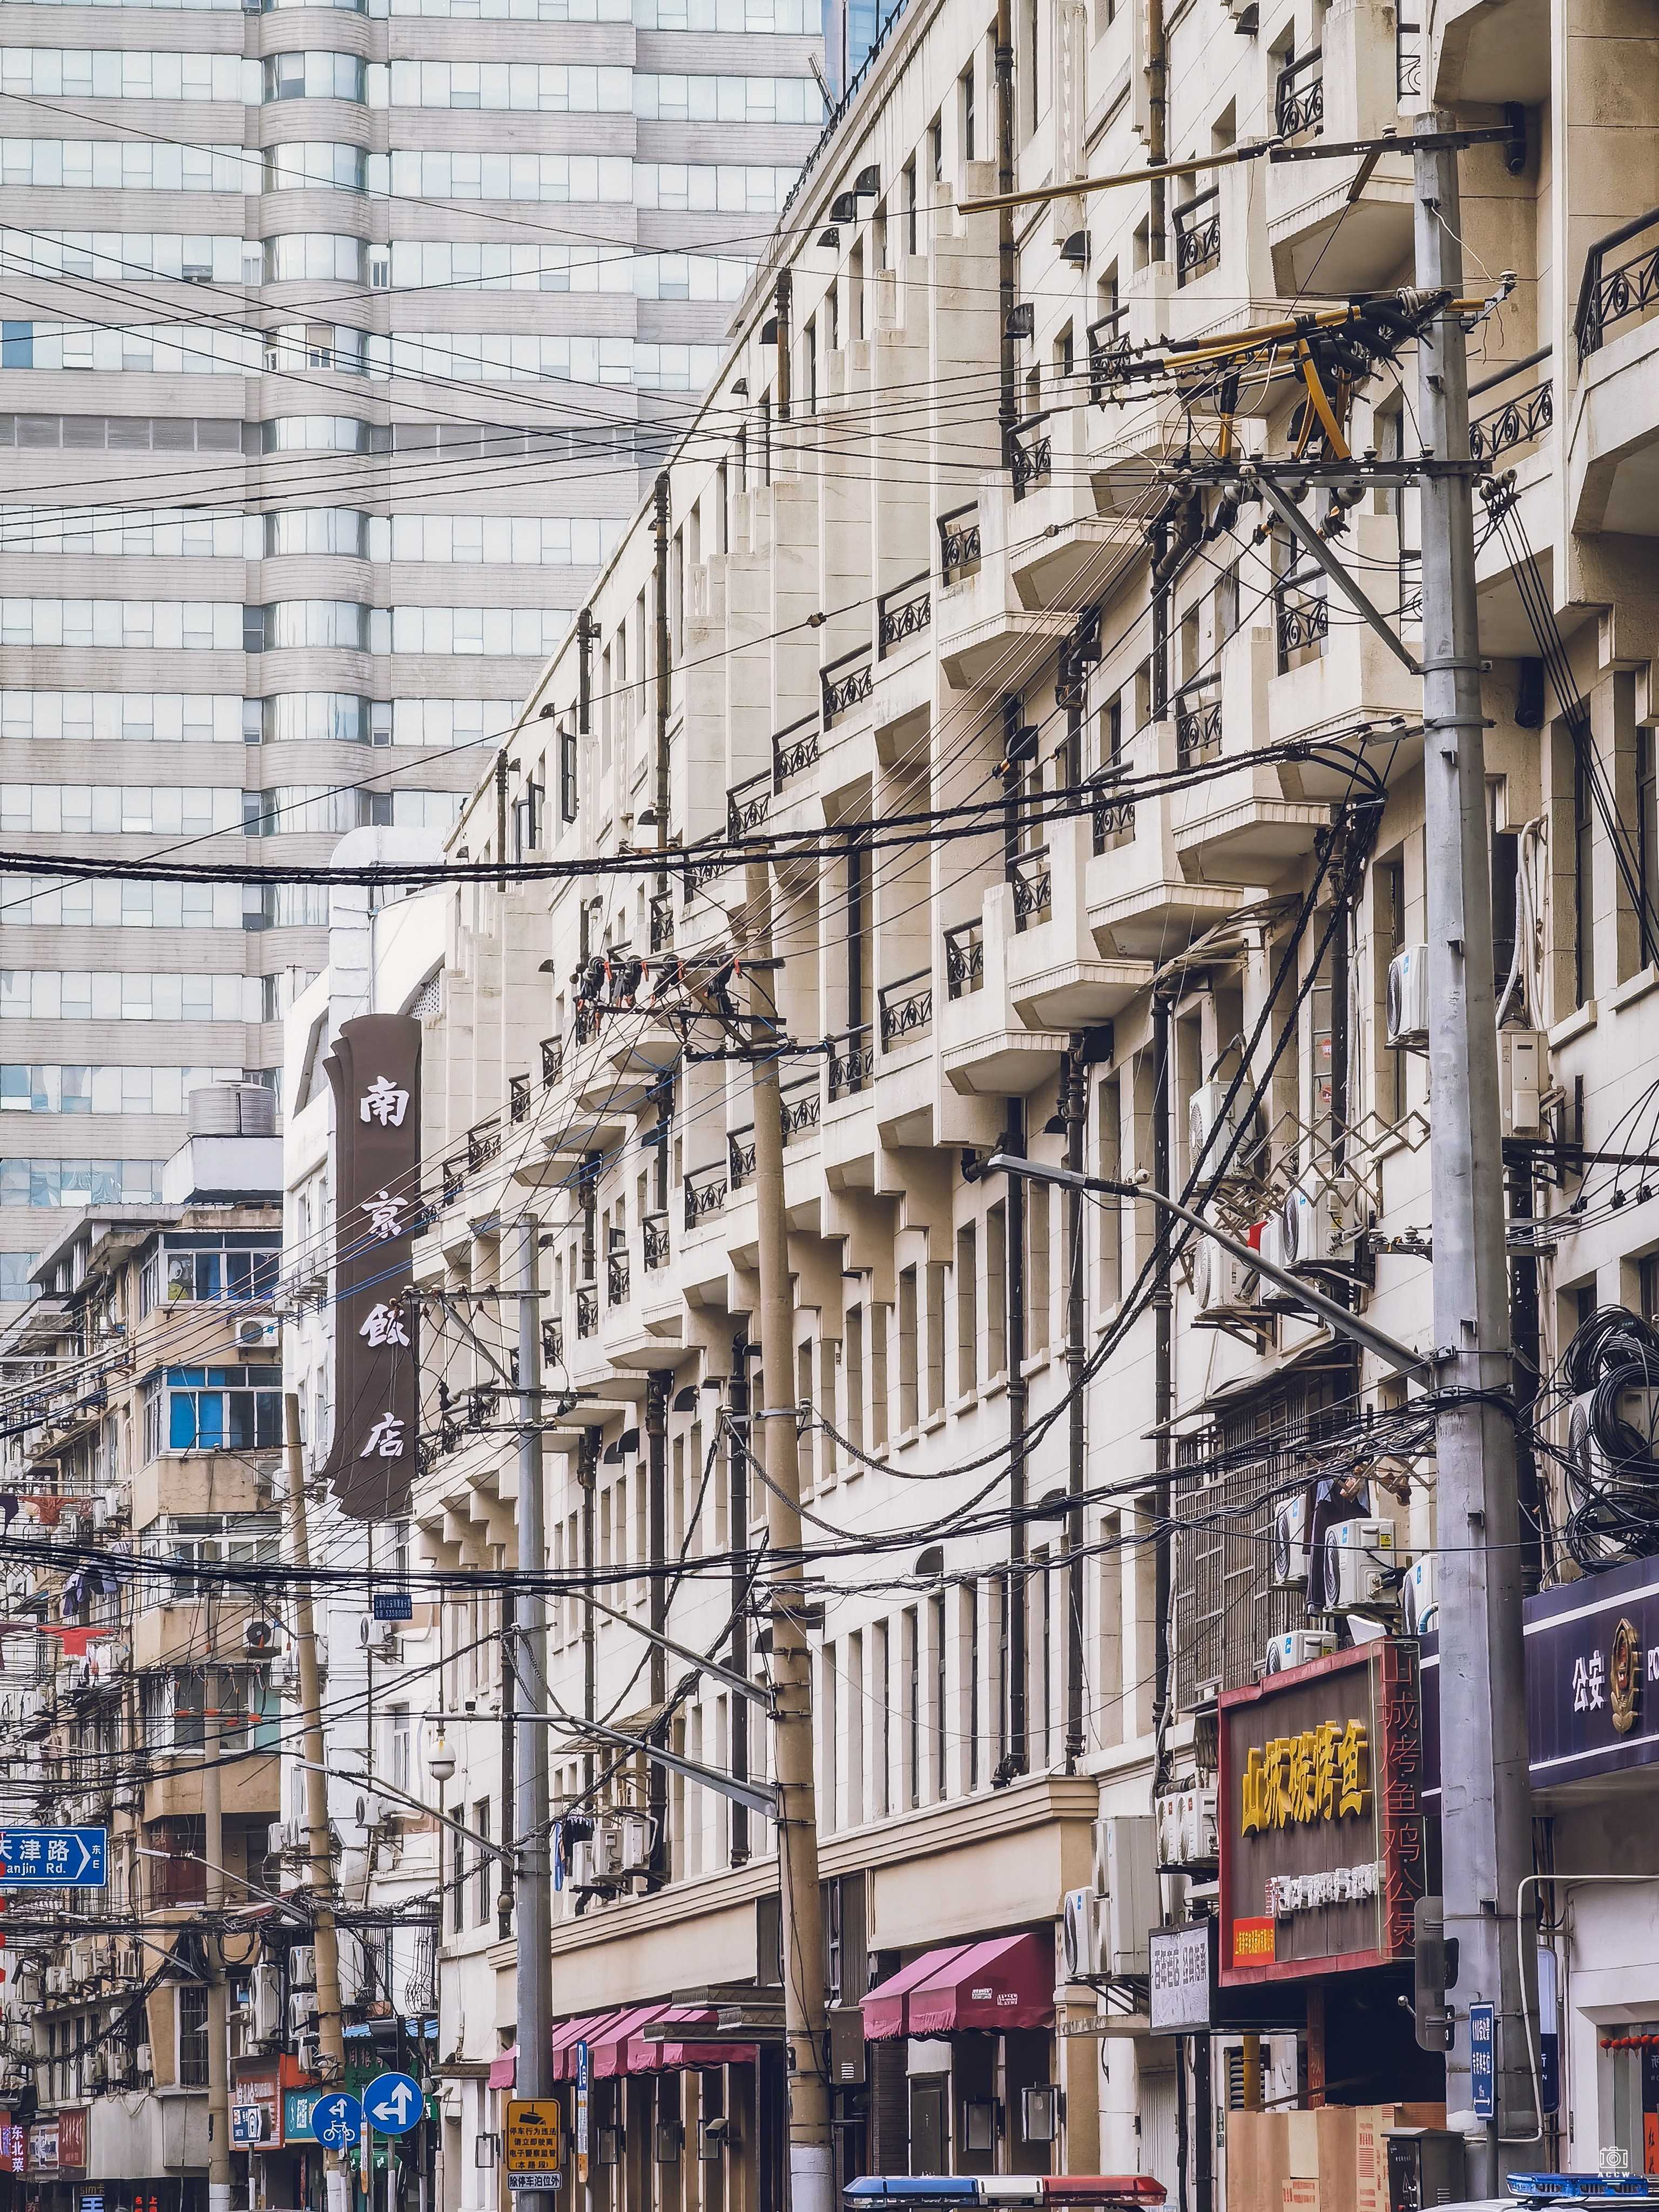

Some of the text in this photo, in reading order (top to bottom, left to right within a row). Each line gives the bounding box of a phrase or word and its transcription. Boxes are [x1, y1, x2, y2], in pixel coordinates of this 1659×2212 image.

[1572, 1650, 1605, 1712] 公安
[0, 1839, 69, 1861] 天津路
[92, 1845, 101, 1854] 东
[6, 1863, 66, 1876] anjin Rd.
[93, 1860, 100, 1869] E
[510, 2127, 556, 2135] 停车行为违法
[11, 2125, 24, 2173] 东北菜
[509, 2175, 559, 2187] 除停车泊位外
